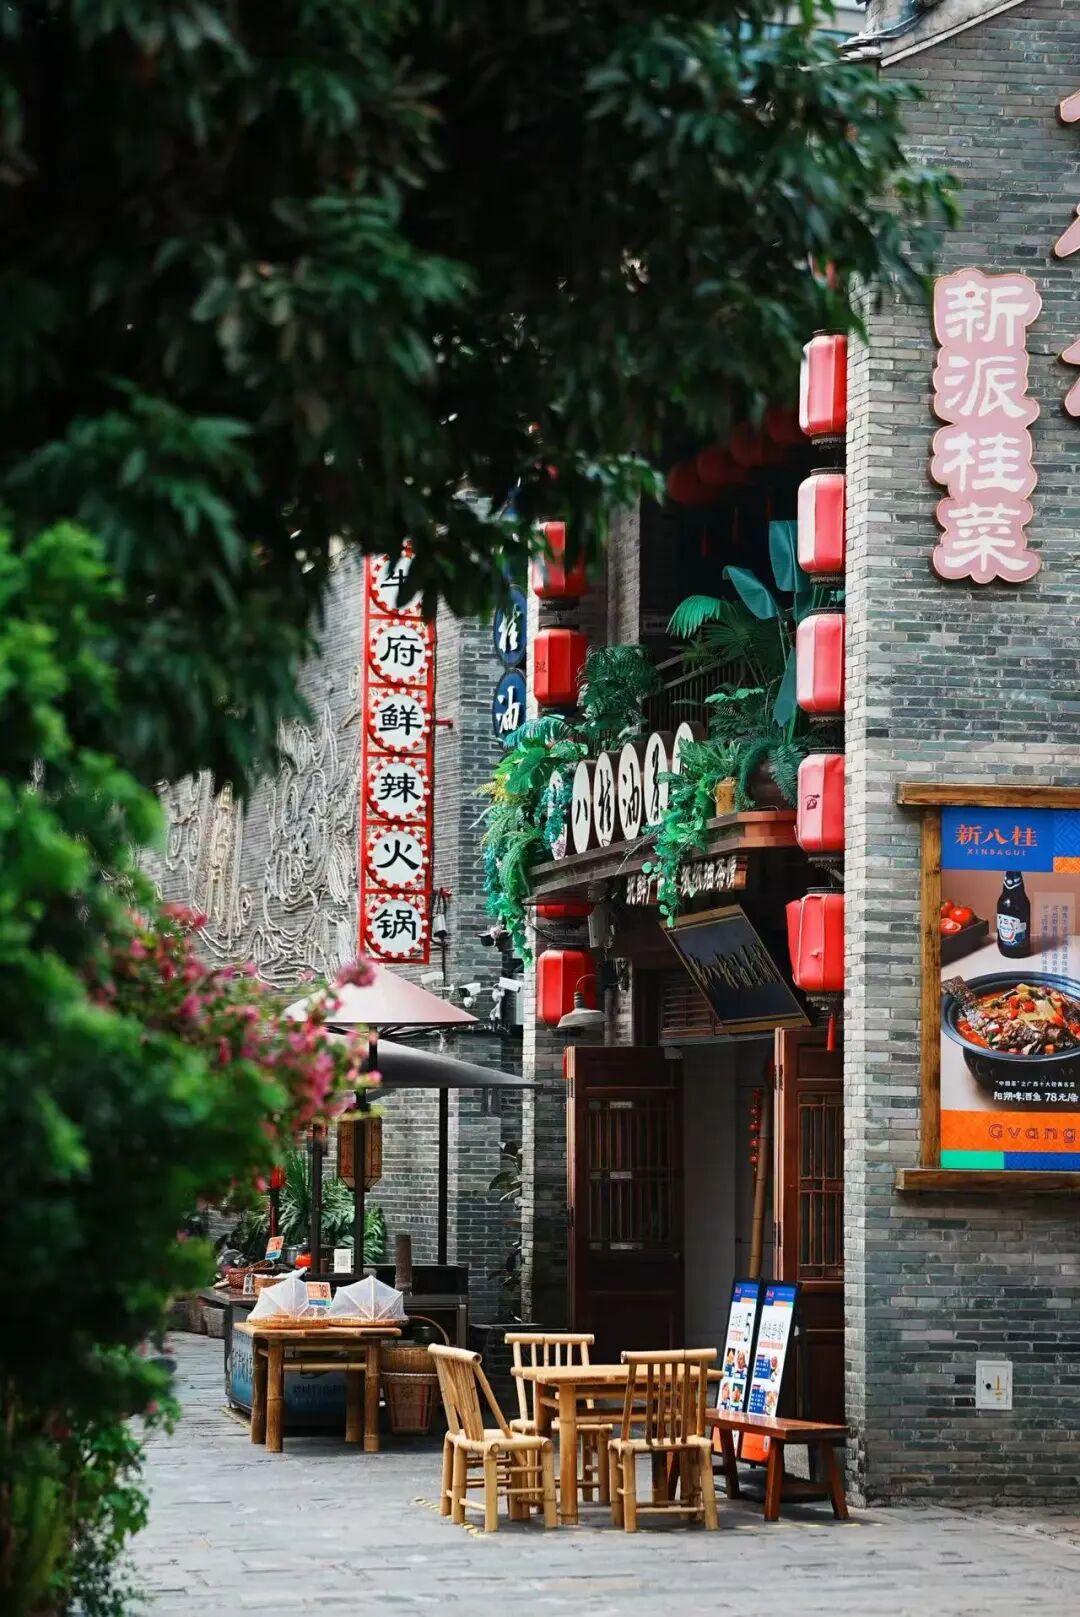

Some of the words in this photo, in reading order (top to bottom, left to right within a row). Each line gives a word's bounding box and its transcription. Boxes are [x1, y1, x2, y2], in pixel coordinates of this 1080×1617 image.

[943, 279, 1031, 573] 新派桂菜
[955, 824, 1038, 847] 新八桂
[967, 848, 1026, 856] XINBAGUI
[988, 1123, 1076, 1144] Gvang
